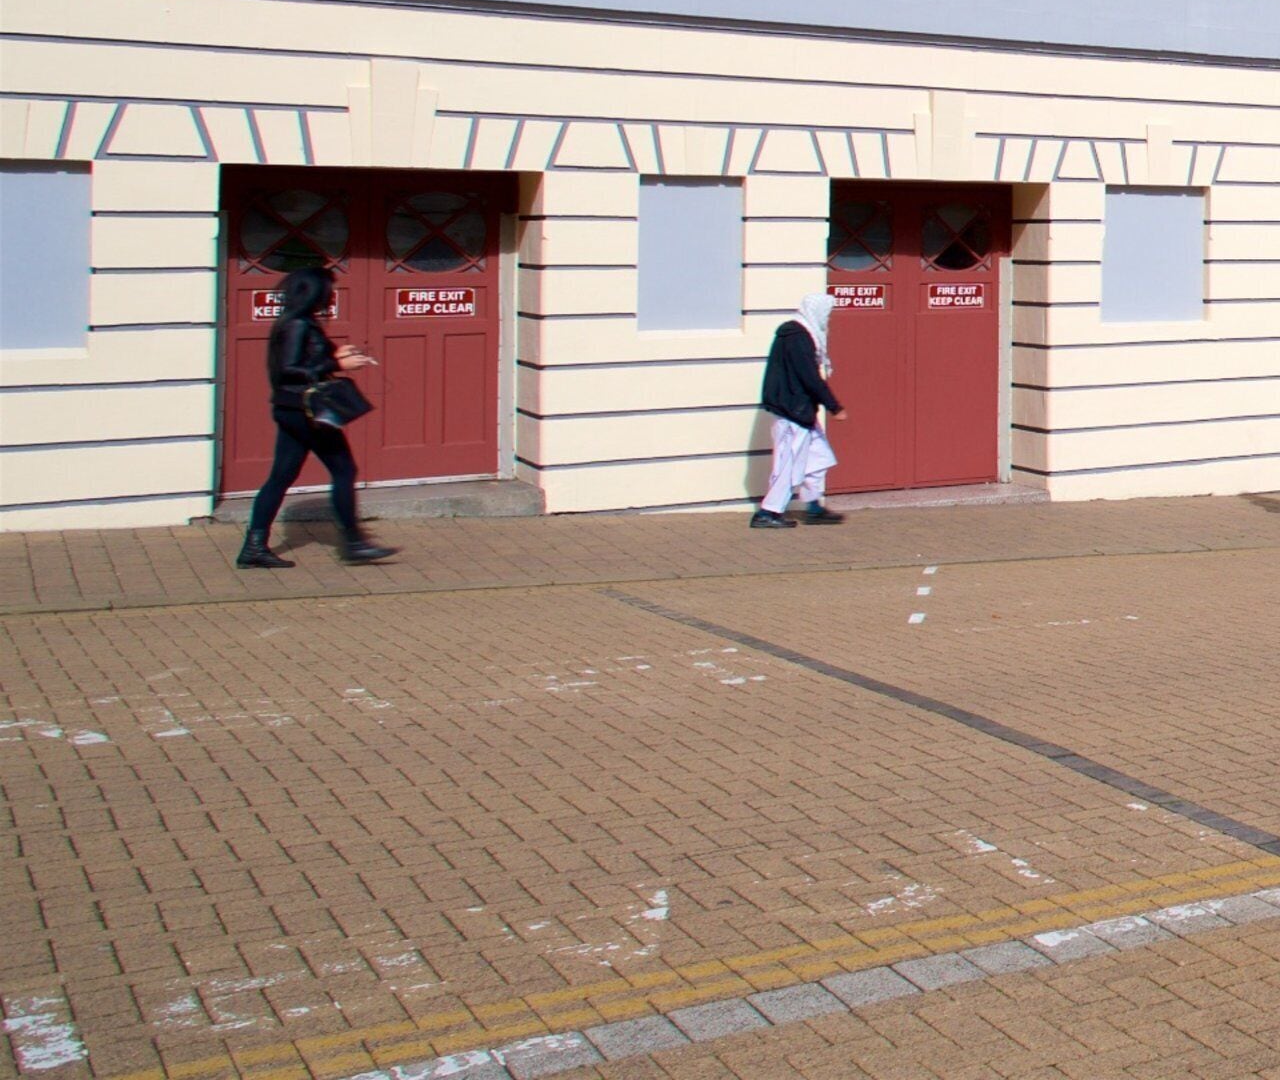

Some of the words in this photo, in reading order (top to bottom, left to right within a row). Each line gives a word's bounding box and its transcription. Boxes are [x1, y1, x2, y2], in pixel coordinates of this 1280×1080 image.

[835, 287, 855, 296] FIRE
[857, 287, 877, 296] EXIT
[937, 287, 956, 295] FIRE
[958, 286, 976, 295] EXIT
[408, 291, 435, 301] FIRE
[439, 291, 465, 301] EXIT
[930, 297, 952, 305] KEEP
[954, 296, 983, 305] CLEAR
[833, 297, 851, 306] EEP
[853, 297, 883, 306] CLEAR
[254, 305, 285, 316] KEE
[398, 304, 430, 314] KEEP
[433, 303, 473, 313] CLEAR
